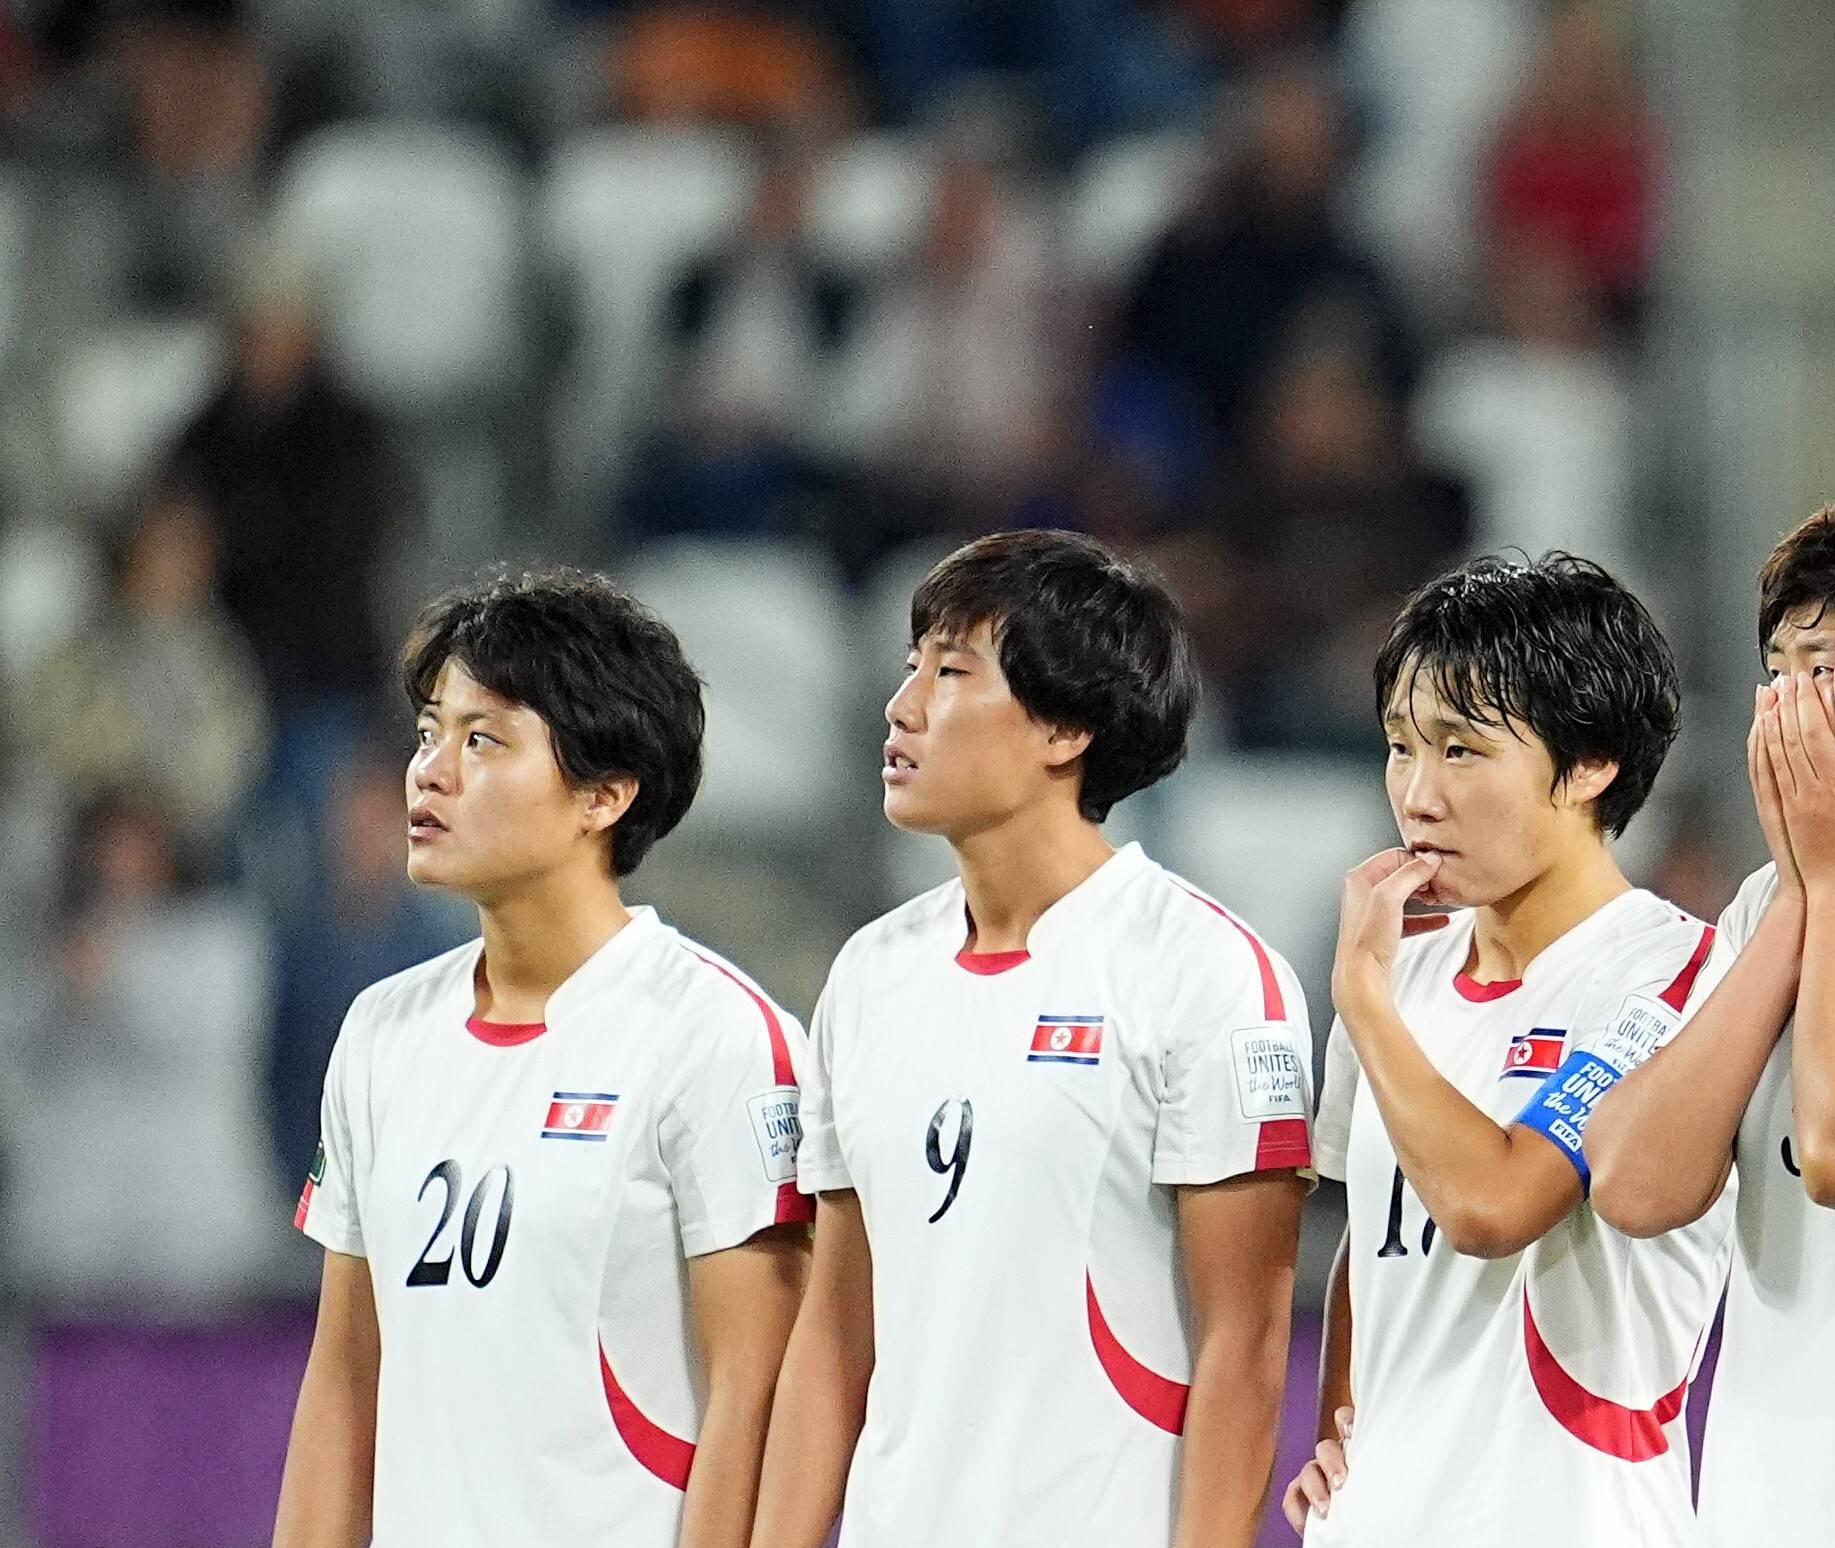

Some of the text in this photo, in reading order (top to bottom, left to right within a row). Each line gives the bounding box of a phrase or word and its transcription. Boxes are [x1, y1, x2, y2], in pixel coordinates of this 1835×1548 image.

[1244, 1040, 1295, 1055] FOOTBALL
[1247, 1054, 1298, 1074] UNITES
[1269, 1095, 1291, 1103] FIFA
[1554, 1122, 1579, 1148] FIFA
[926, 1095, 973, 1224] 9
[406, 1158, 514, 1289] 20
[1377, 1163, 1436, 1258] 1
